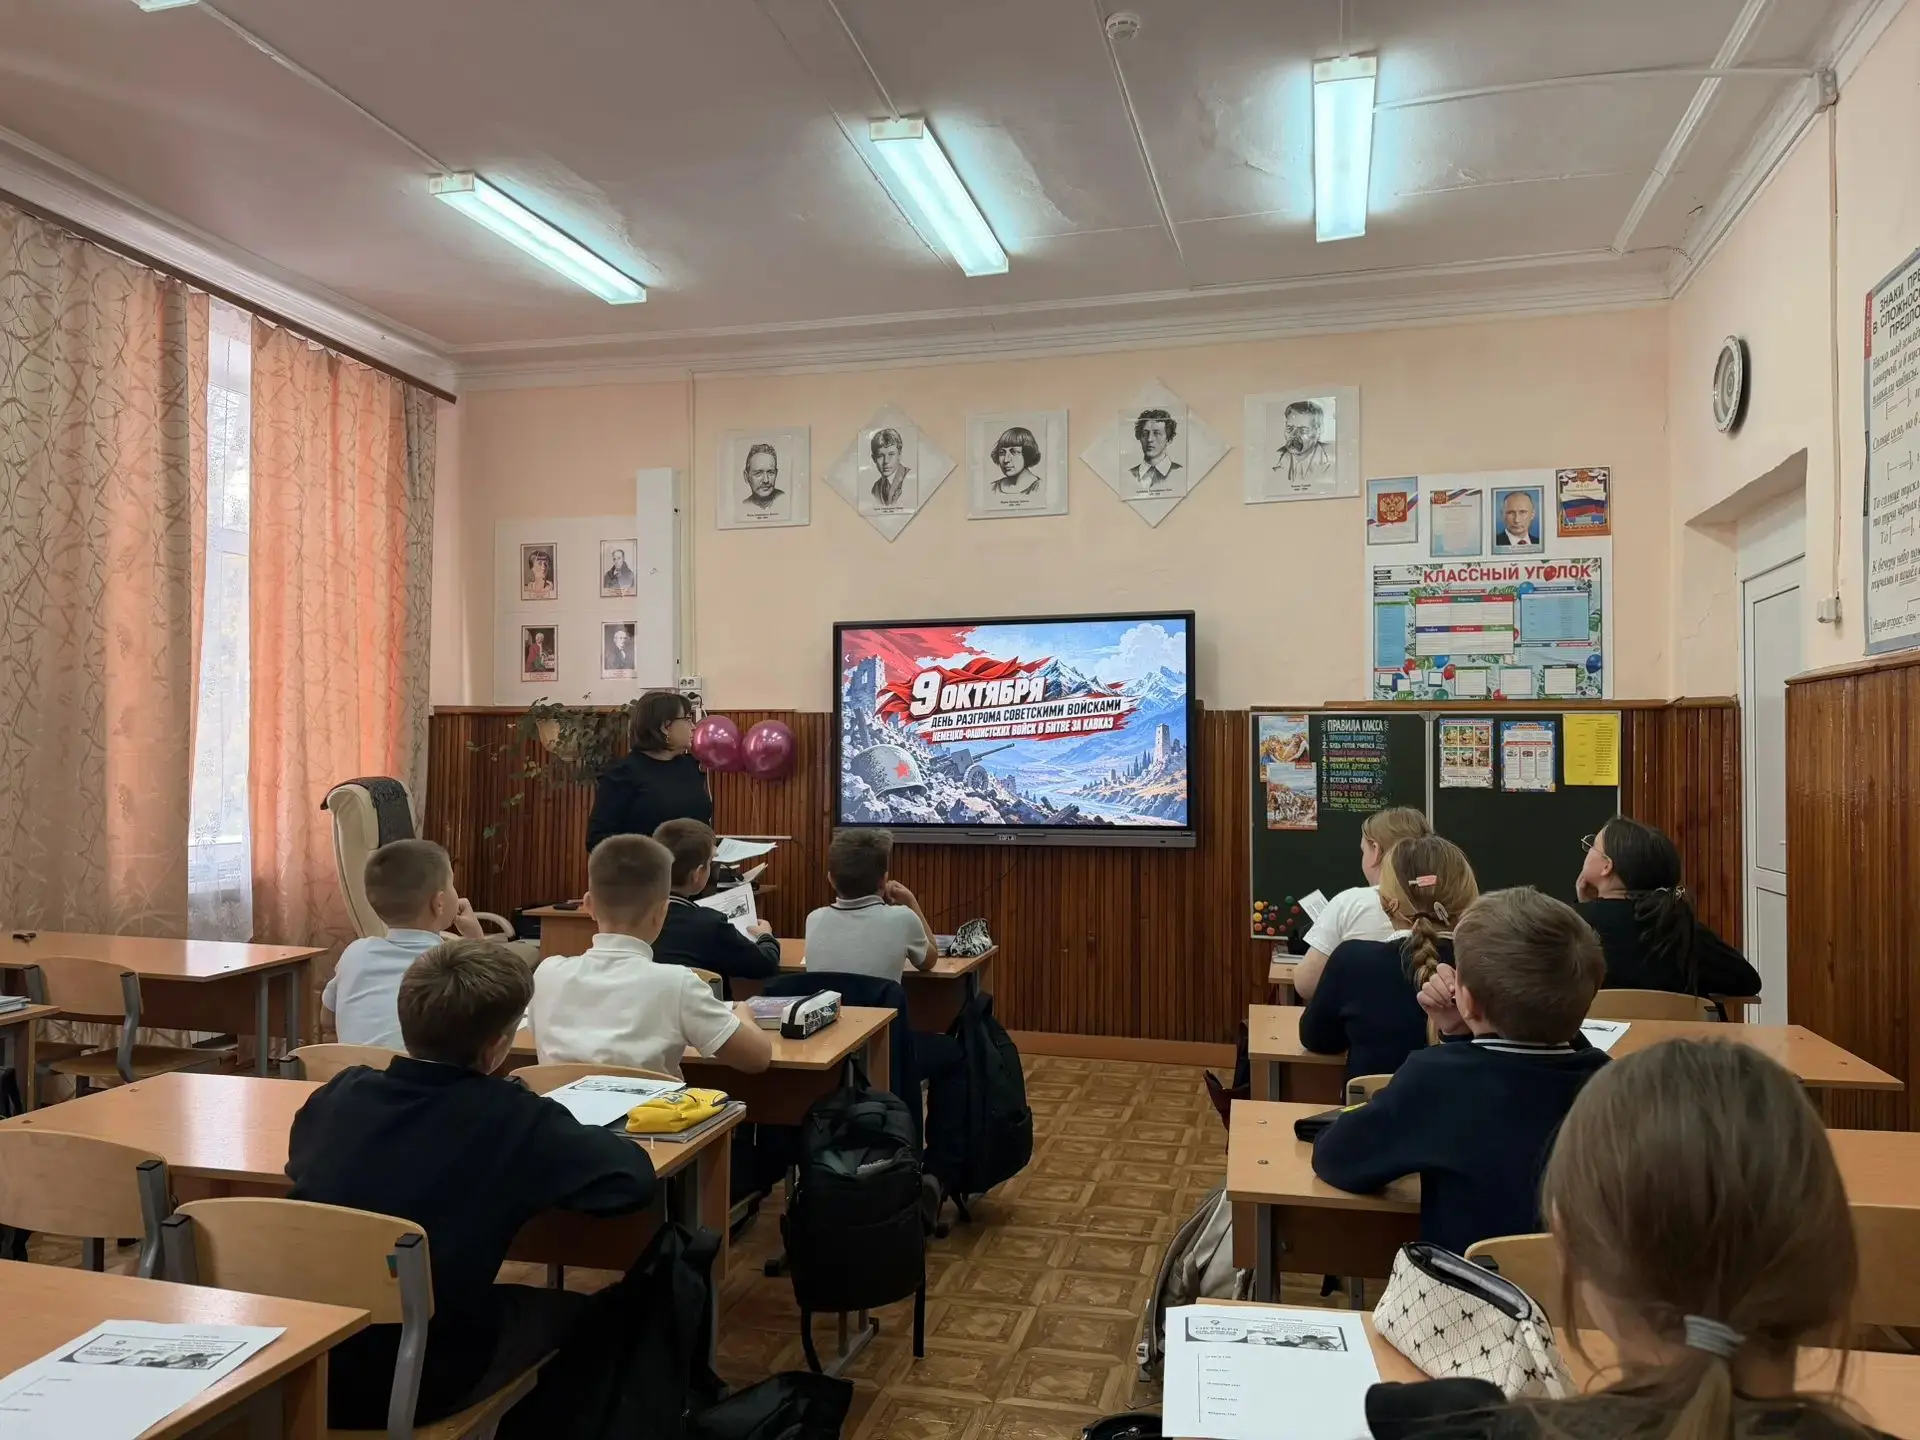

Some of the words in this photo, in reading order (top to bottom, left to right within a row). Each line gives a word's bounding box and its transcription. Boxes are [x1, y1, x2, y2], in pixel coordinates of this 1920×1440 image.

[1873, 321, 1878, 335] В
[1880, 288, 1920, 328] СЛОЖНОС
[1880, 282, 1904, 313] ЗНАКИ
[1424, 563, 1519, 583] КЛАССНЫЙ
[910, 671, 941, 716] 9
[940, 677, 1046, 711] ОКТЯБРЯ
[931, 714, 954, 729] ДЕНЬ
[956, 710, 1001, 726] РАЗГРОМА
[1004, 706, 1064, 722] СОВЕТСКИМИ
[1068, 699, 1121, 716] ВОЙСКАМИ
[1328, 720, 1360, 731] ПРАВИЛА
[1362, 720, 1383, 731] КЛАССА
[932, 724, 1010, 742] НЕМЕЦКО-ФАШИСТСКИХ
[1012, 722, 1036, 736] ВОЙСК
[1038, 723, 1044, 734] В
[1046, 721, 1070, 733] БИТВЕ
[1071, 720, 1082, 732] ЗА
[1084, 717, 1113, 730] КАВКАЗ
